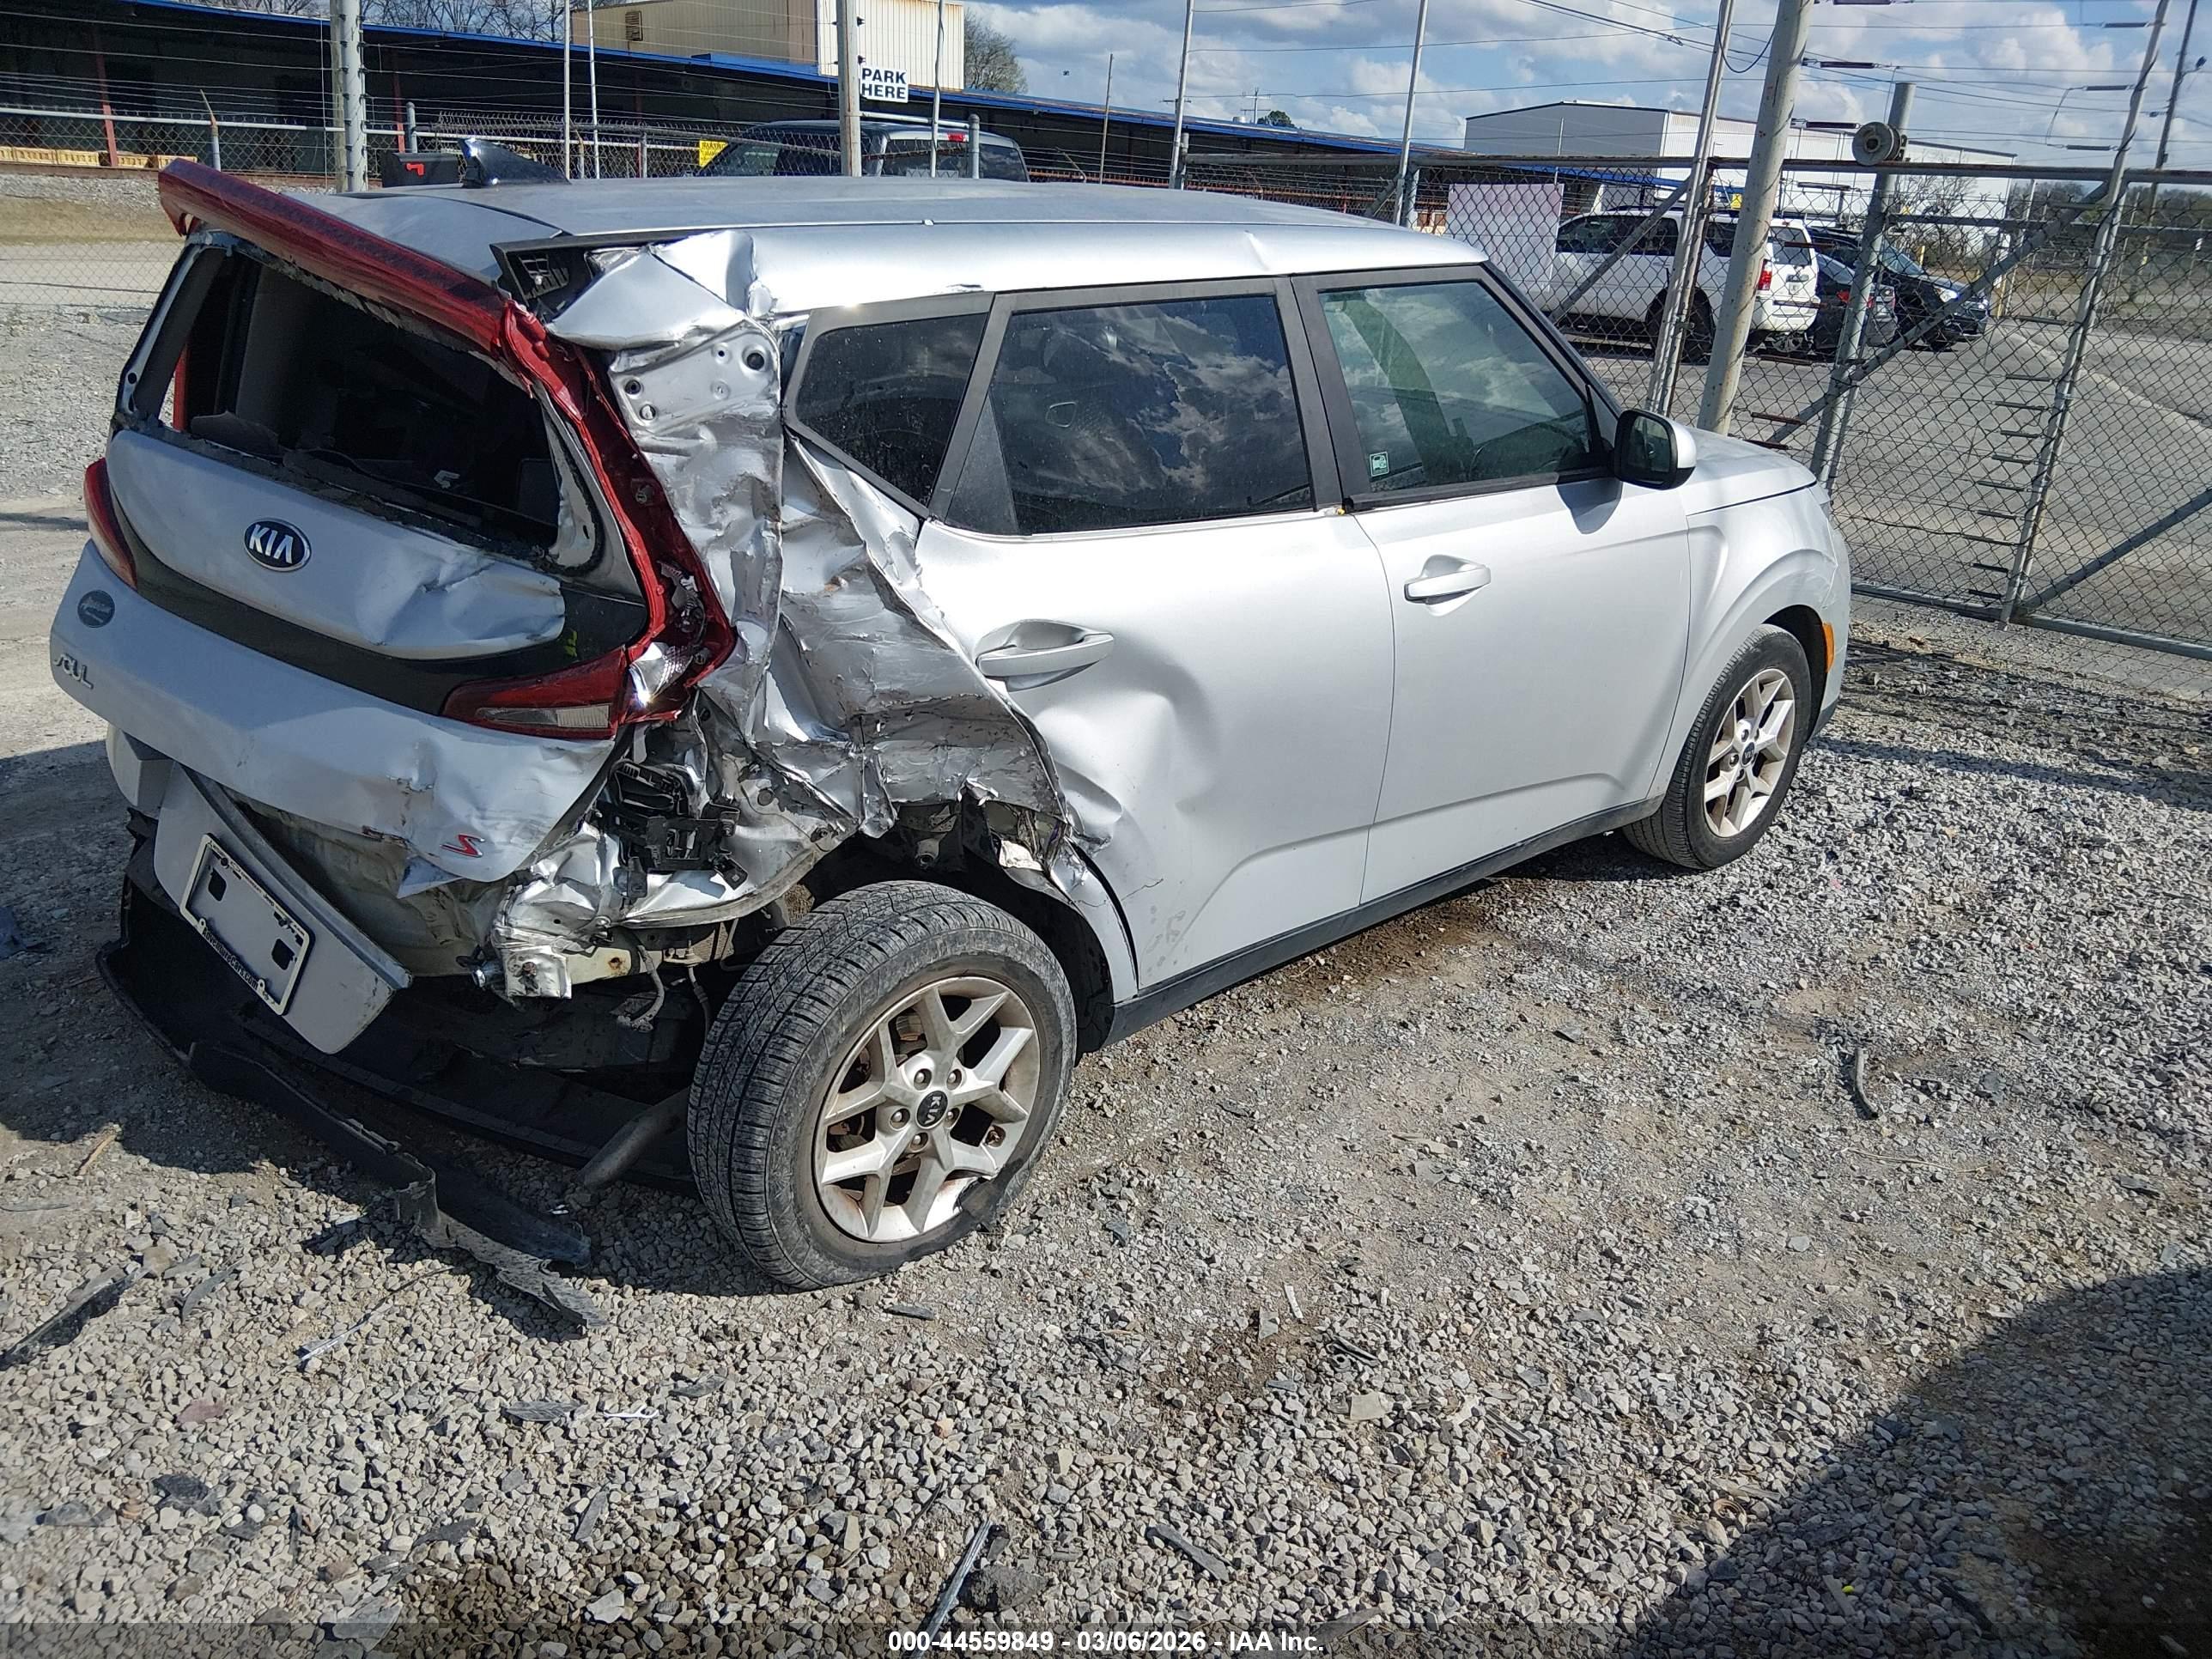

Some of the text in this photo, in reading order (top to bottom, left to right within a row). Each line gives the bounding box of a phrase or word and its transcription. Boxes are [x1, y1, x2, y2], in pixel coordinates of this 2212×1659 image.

[861, 68, 906, 84] PARK
[861, 83, 906, 100] HERE
[249, 524, 293, 564] KIA
[439, 833, 485, 858] S
[924, 1096, 942, 1125] KIA
